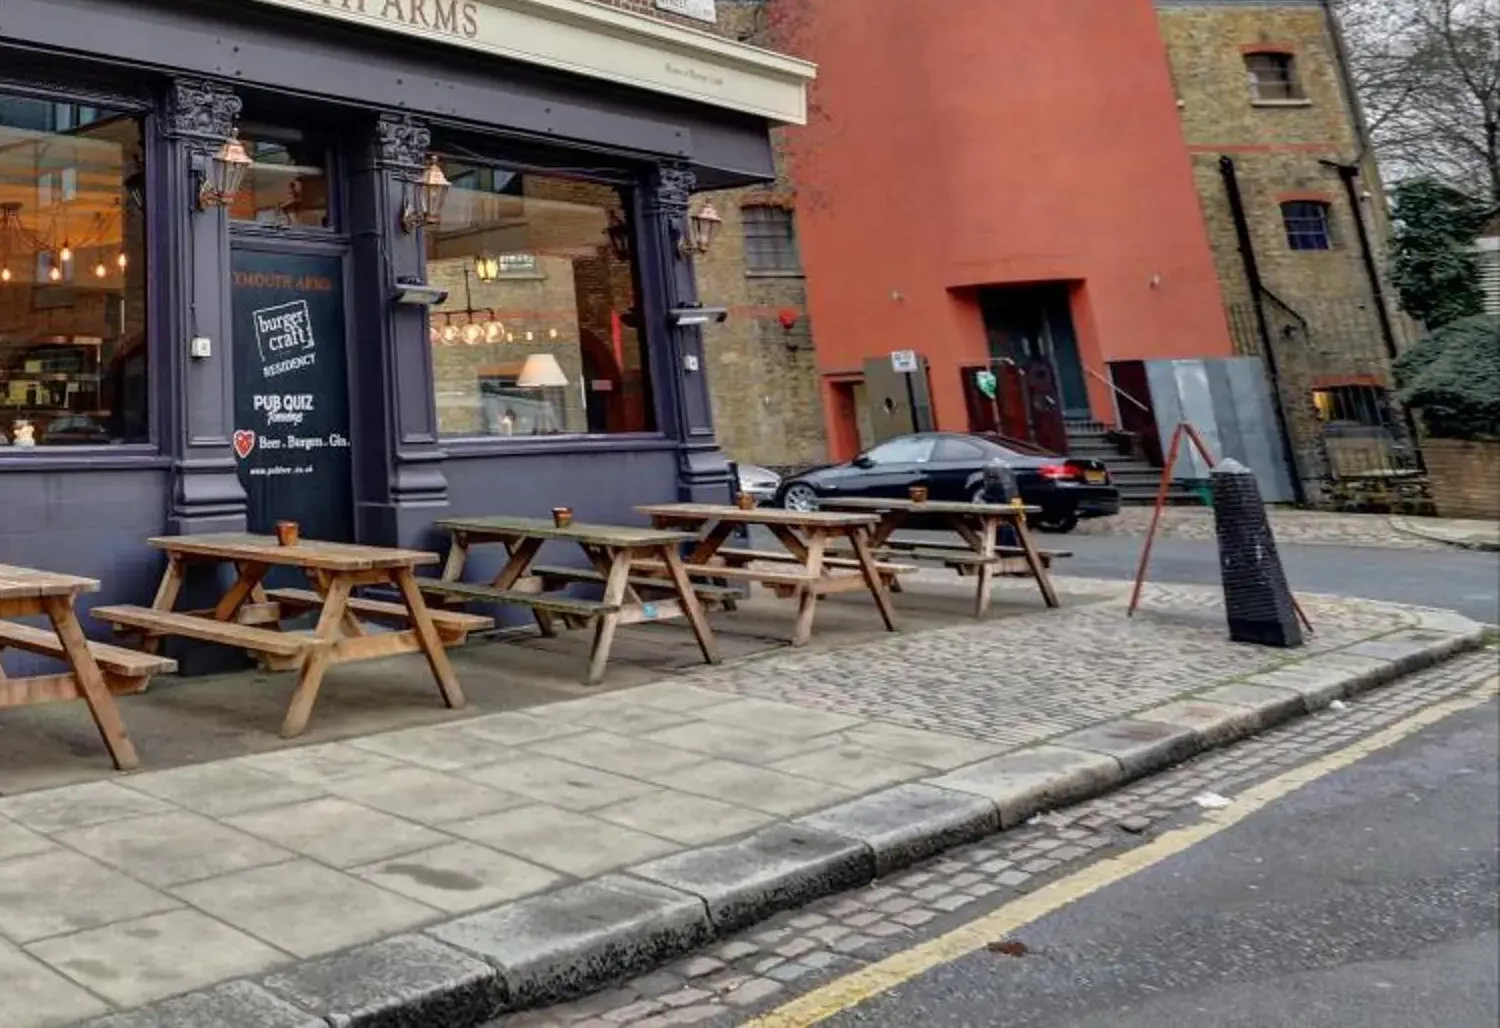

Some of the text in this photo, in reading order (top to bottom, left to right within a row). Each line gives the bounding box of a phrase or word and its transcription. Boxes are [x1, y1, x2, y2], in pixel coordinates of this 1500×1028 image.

[257, 311, 305, 333] burger
[269, 324, 306, 351] craft
[253, 394, 315, 412] PUB QUIZ
